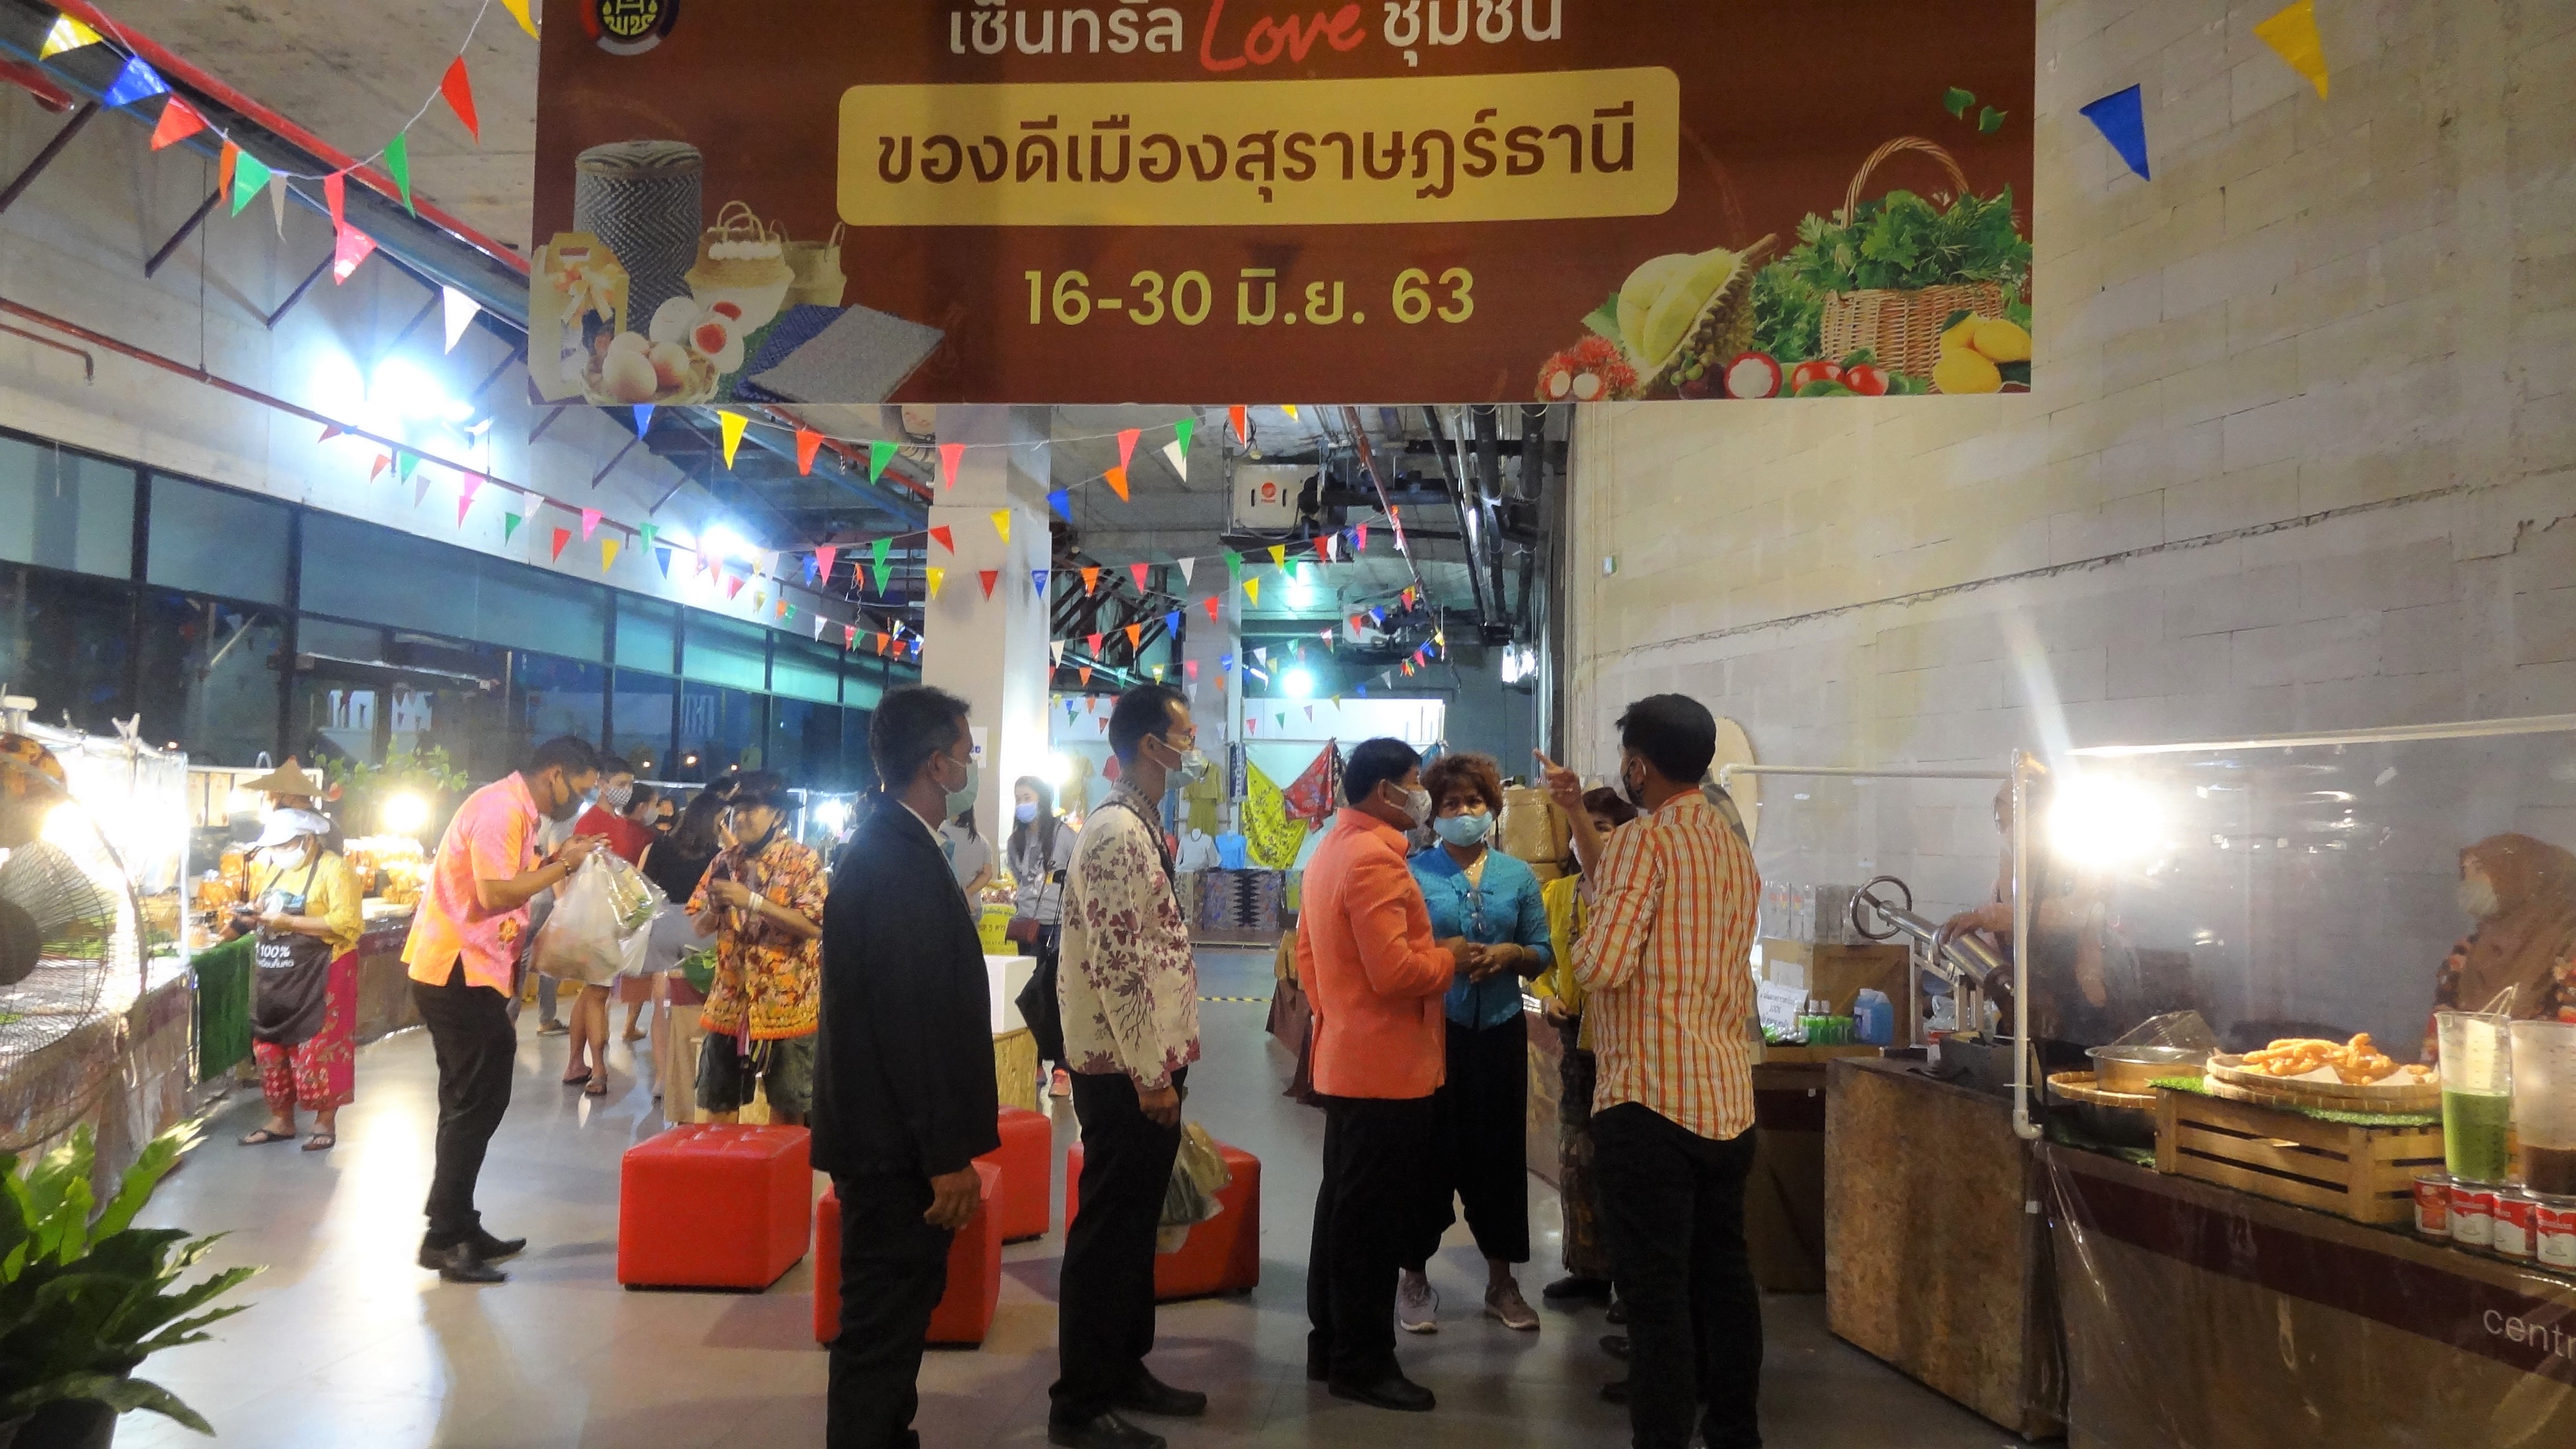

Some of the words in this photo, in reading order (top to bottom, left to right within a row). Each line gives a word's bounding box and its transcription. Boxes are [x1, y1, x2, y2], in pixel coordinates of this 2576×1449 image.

[1200, 0, 1366, 72] Love
[1383, 0, 1561, 67] ชุมชน
[1024, 270, 1213, 326] 16-30
[1237, 268, 1366, 325] มิ.ย.
[1391, 267, 1475, 323] 63
[260, 944, 291, 958] 100%
